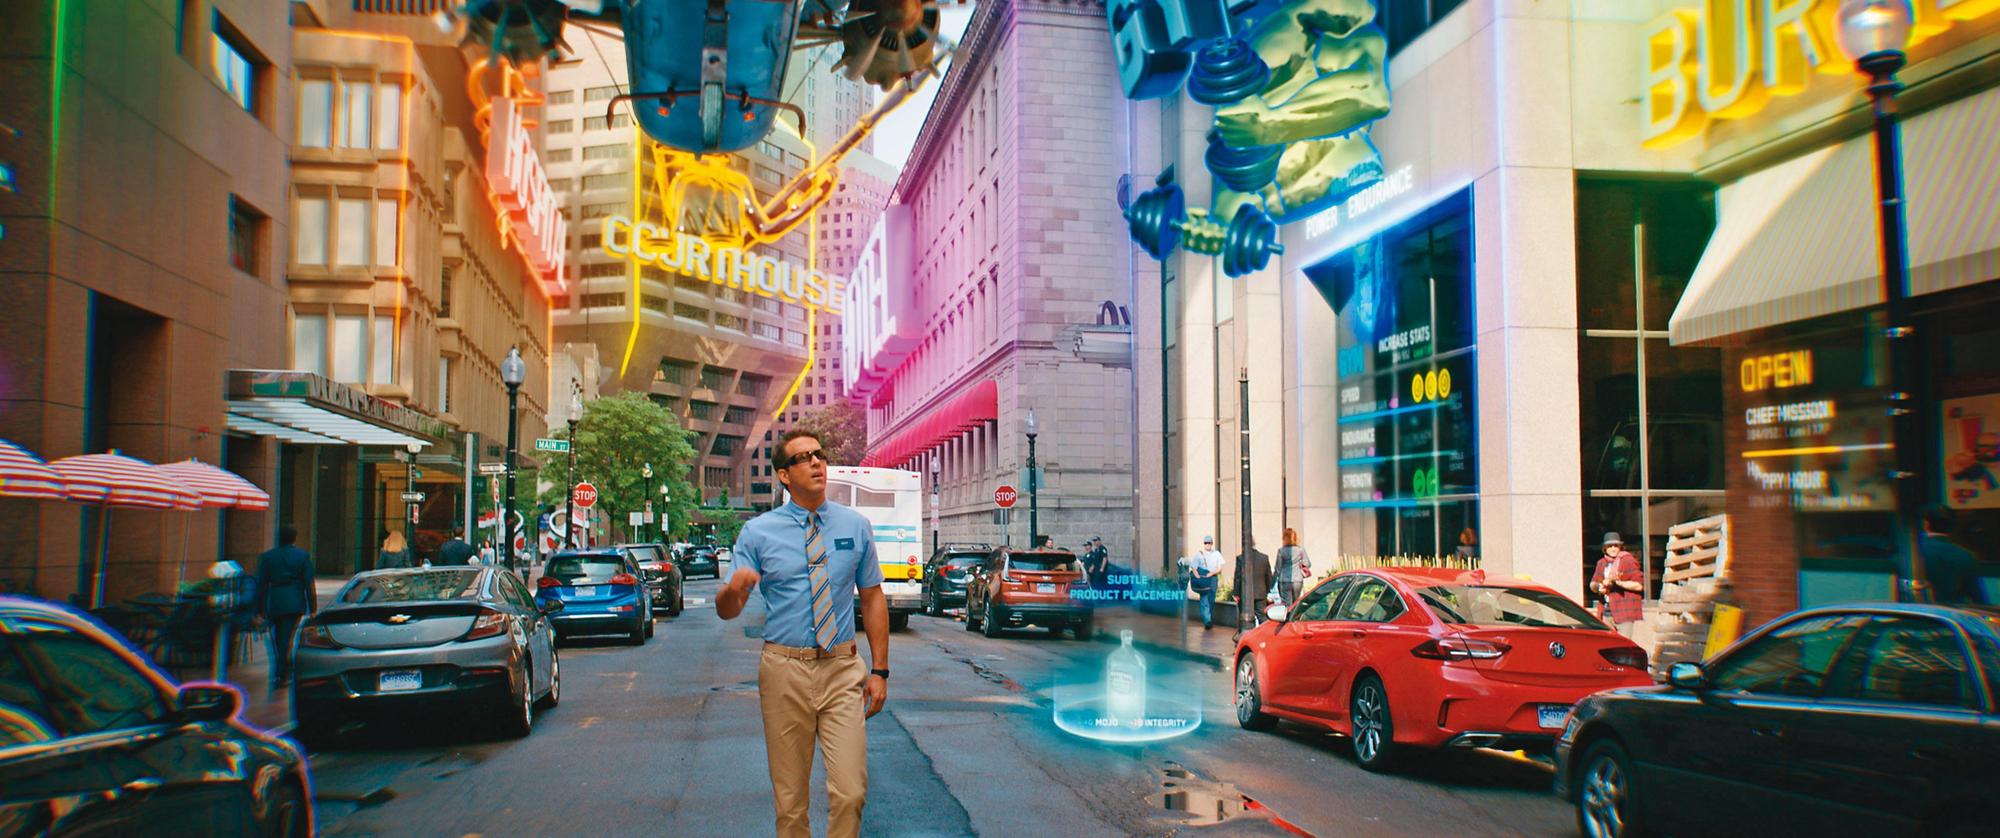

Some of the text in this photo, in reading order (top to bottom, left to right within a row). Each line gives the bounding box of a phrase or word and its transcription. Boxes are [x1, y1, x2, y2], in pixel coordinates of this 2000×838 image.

[503, 97, 568, 292] HOSPITAL
[1306, 164, 1413, 241] POWER ENDURANCE
[842, 209, 897, 397] HOTEL
[1378, 331, 1409, 353] INCREASE
[1409, 325, 1431, 345] STATS
[1740, 350, 1813, 392] OPEN
[1341, 386, 1360, 403] SPEED
[1745, 400, 1837, 425] CHEF MISSION
[538, 440, 557, 449] MAIN
[1786, 469, 1829, 490] HOUR
[574, 490, 596, 500] STOP
[995, 491, 1016, 502] STOP
[1106, 574, 1149, 585] SUBTLE
[1069, 590, 1186, 600] PRODUCT PLACEMENT
[1095, 718, 1119, 727] MOJO
[1145, 718, 1187, 727] INTEGRITY
